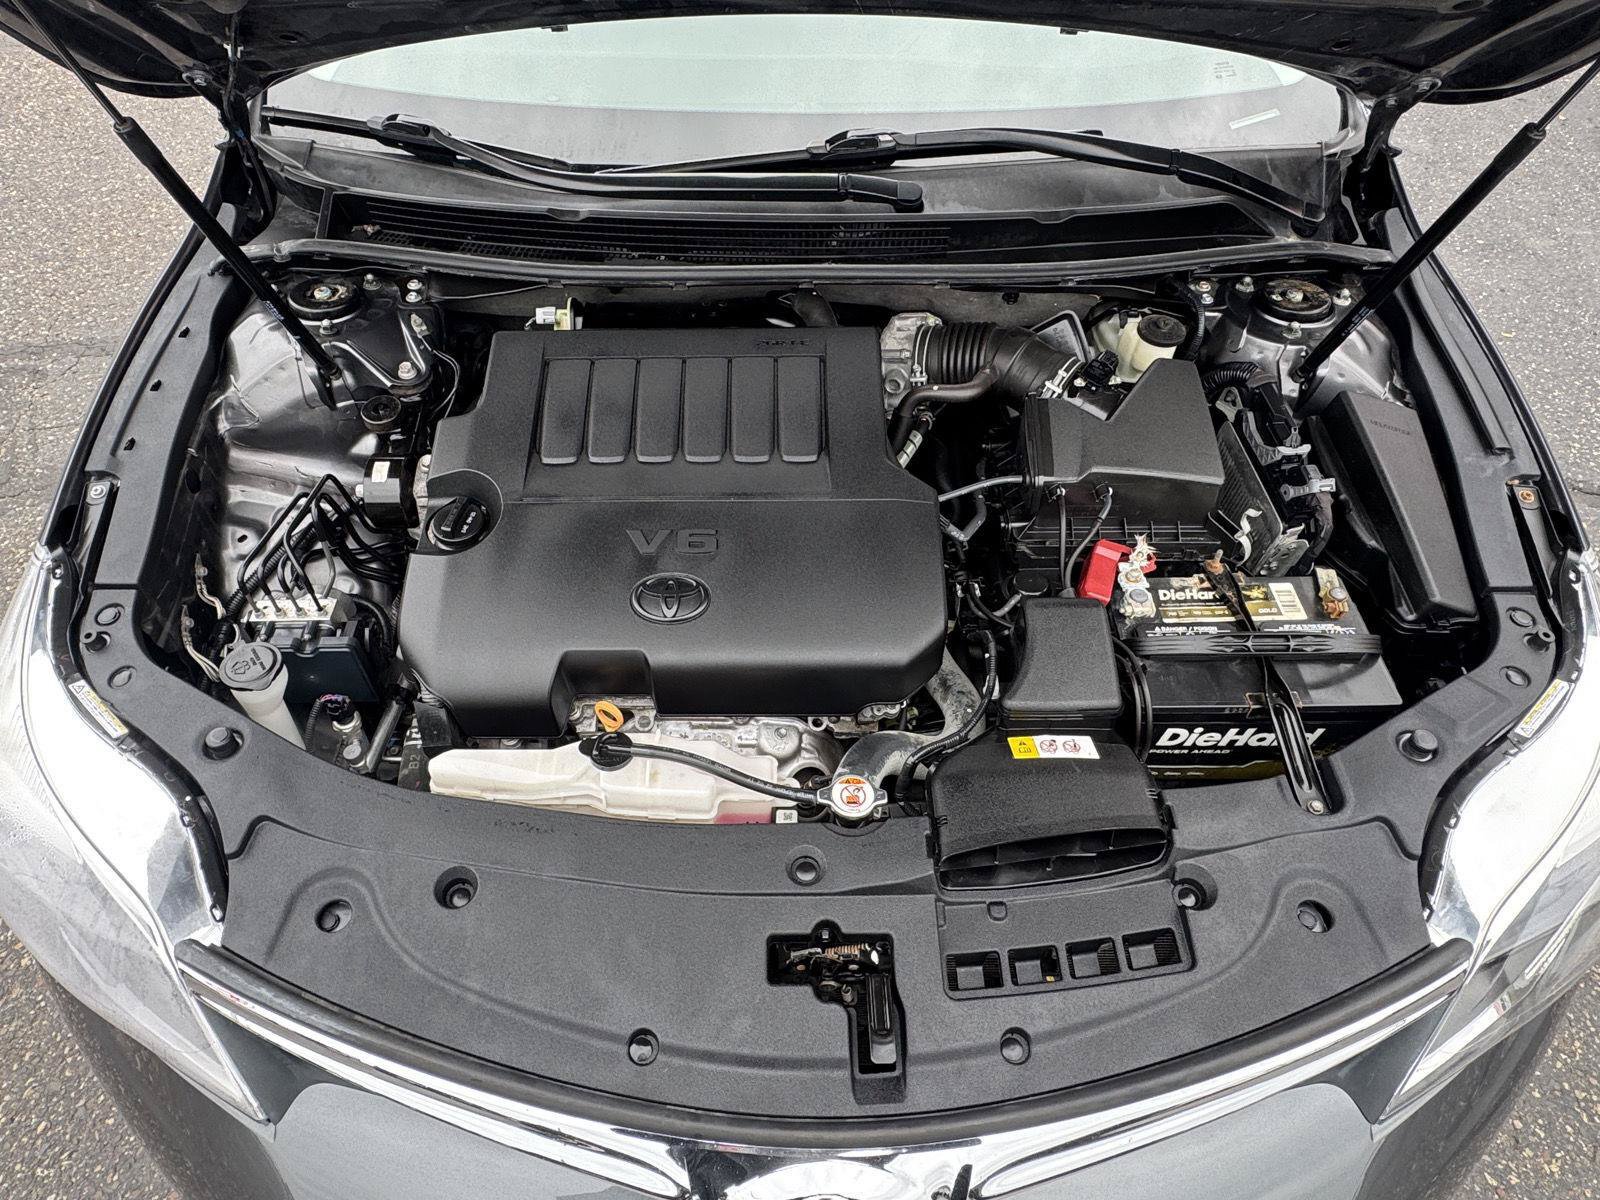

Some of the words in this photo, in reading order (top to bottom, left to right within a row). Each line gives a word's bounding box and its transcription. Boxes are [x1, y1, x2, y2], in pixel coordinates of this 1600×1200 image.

[625, 528, 719, 555] V6
[1158, 588, 1219, 601] DieHar
[1155, 727, 1326, 747] DieHad
